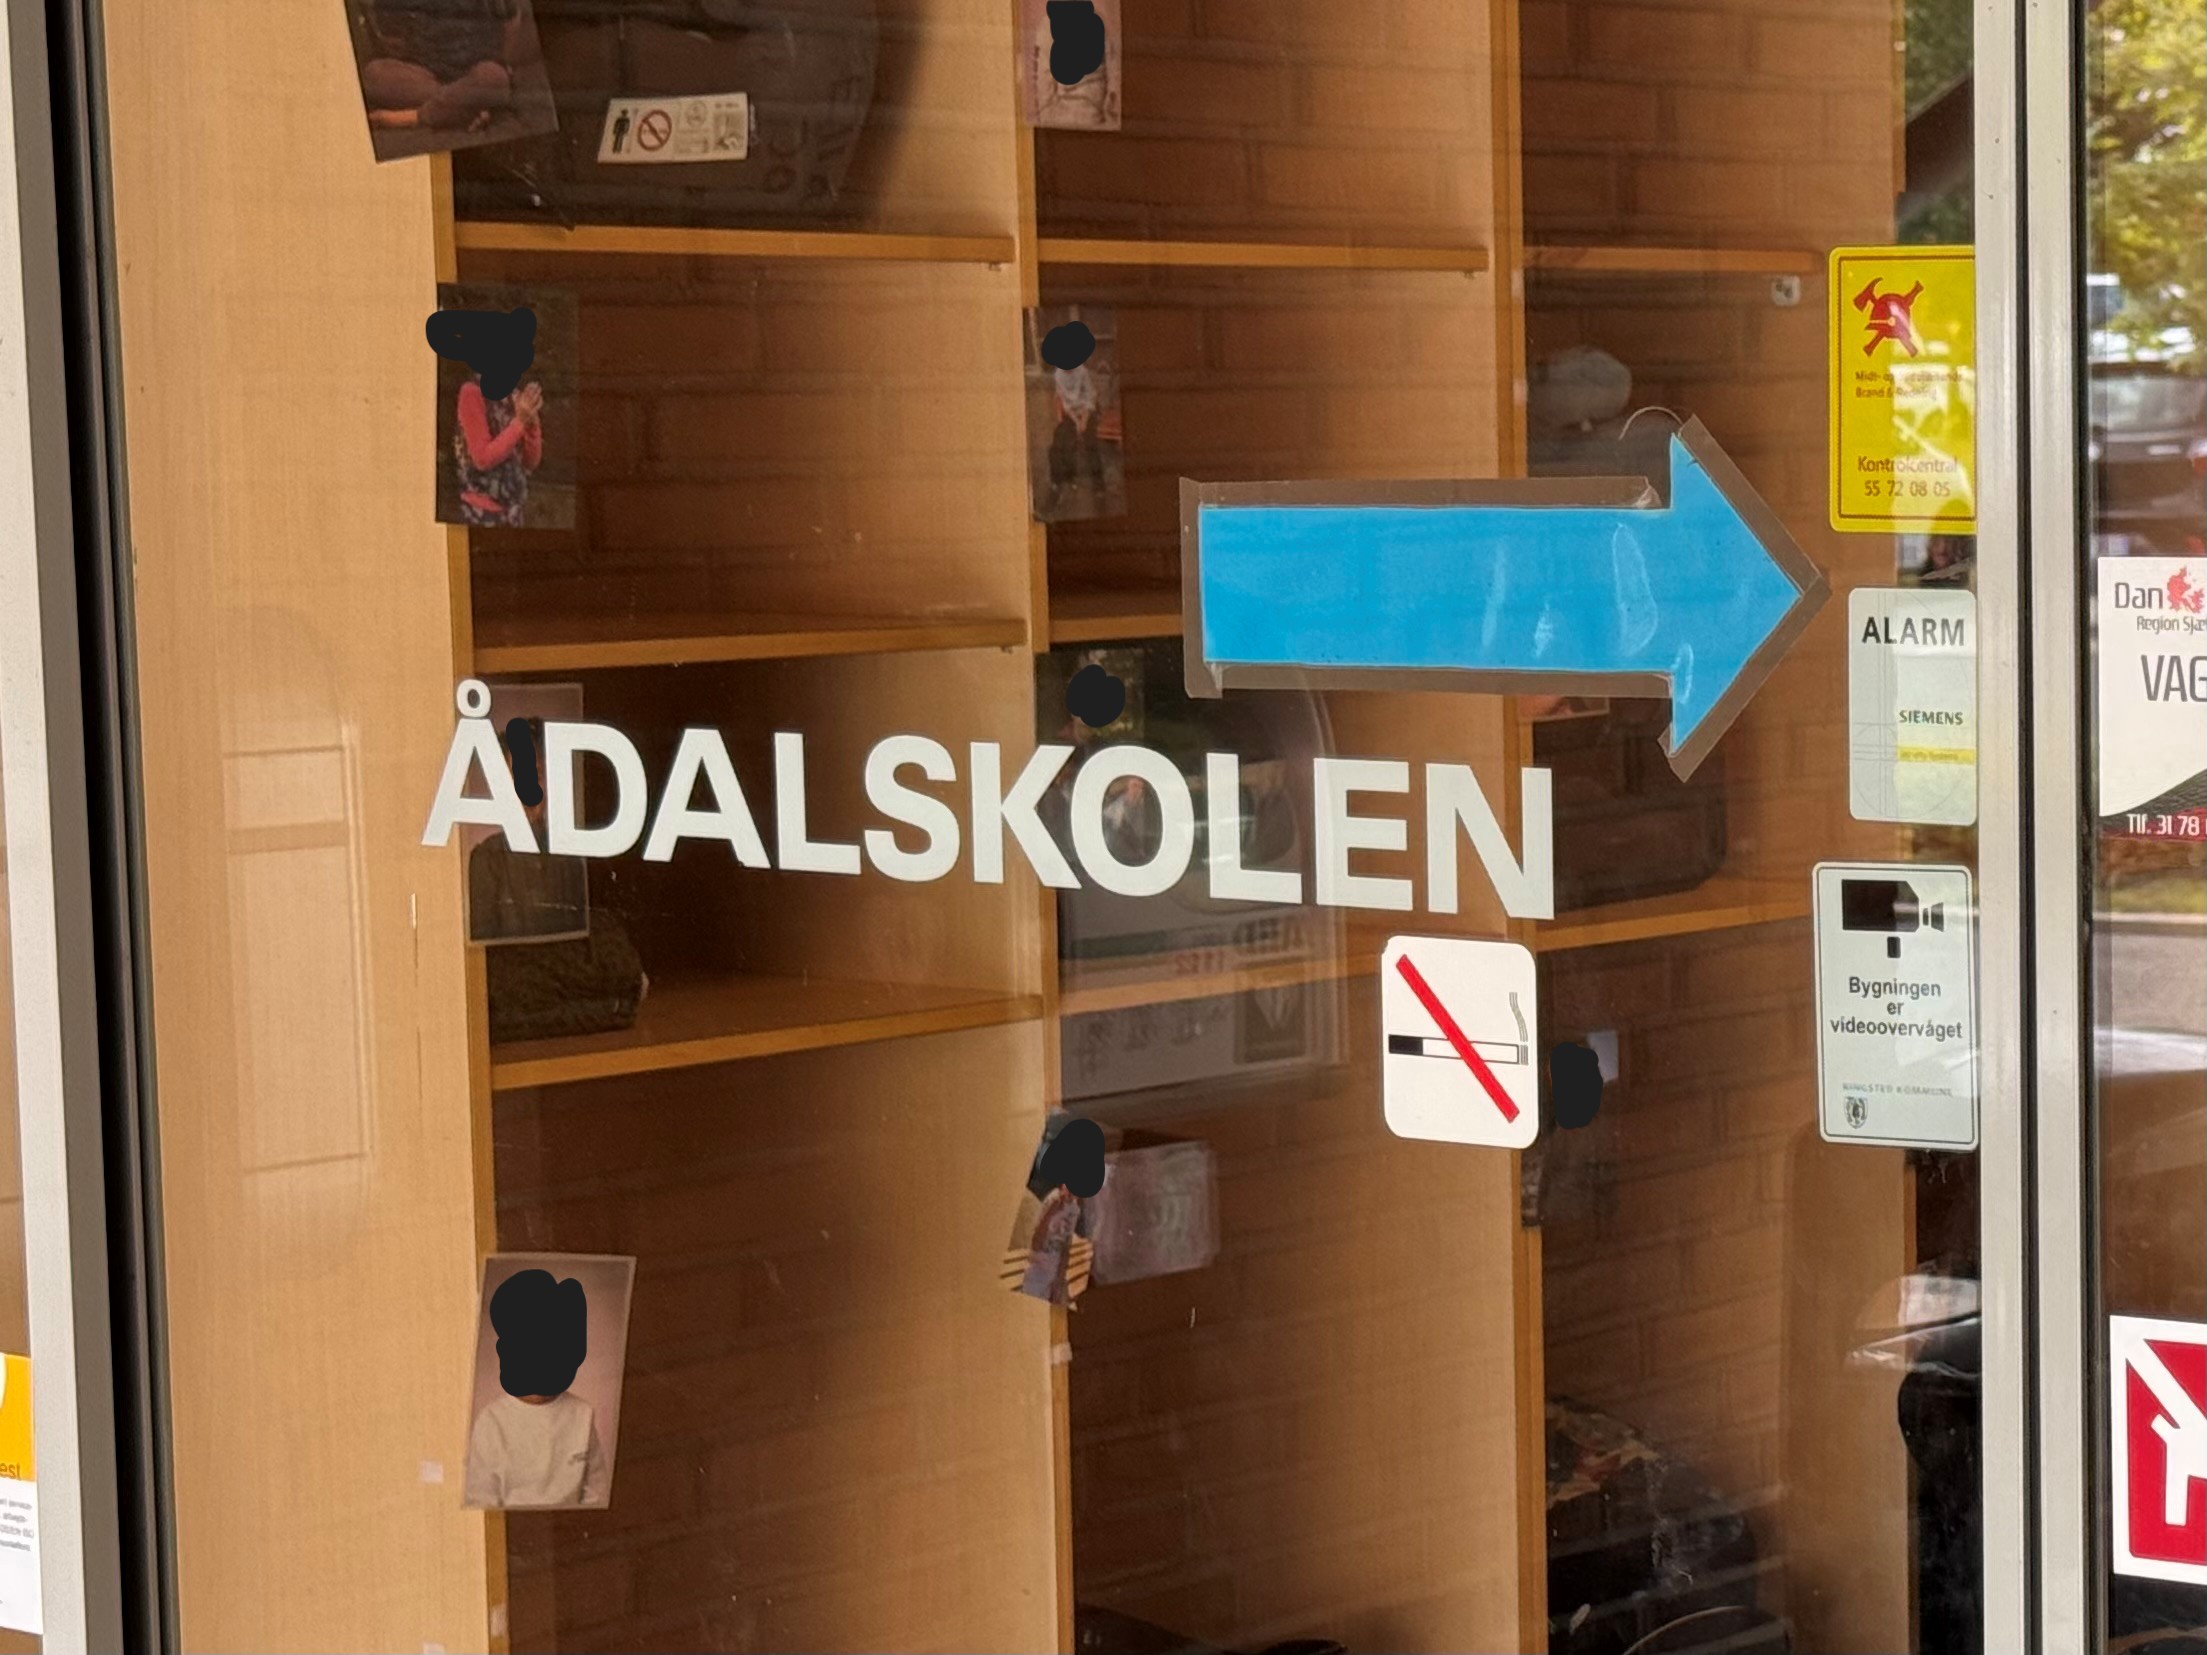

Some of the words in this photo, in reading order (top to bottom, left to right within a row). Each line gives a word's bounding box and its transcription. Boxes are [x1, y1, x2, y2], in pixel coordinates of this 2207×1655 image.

[1864, 480, 1881, 496] 55
[1887, 481, 1904, 496] 72
[1910, 481, 1928, 497] 08
[1933, 481, 1950, 498] 05
[2115, 582, 2163, 609] Dan
[1862, 616, 1965, 646] ALARM
[2137, 616, 2180, 635] Region
[1899, 710, 1964, 726] SIEMENS
[421, 678, 1555, 920] ÅDALSKOLEN
[2156, 814, 2173, 835] 31
[2177, 815, 2200, 836] 78
[1849, 976, 1941, 999] Bygningen
[1887, 1001, 1904, 1015] er
[1830, 1016, 1962, 1042] videoovervåget
